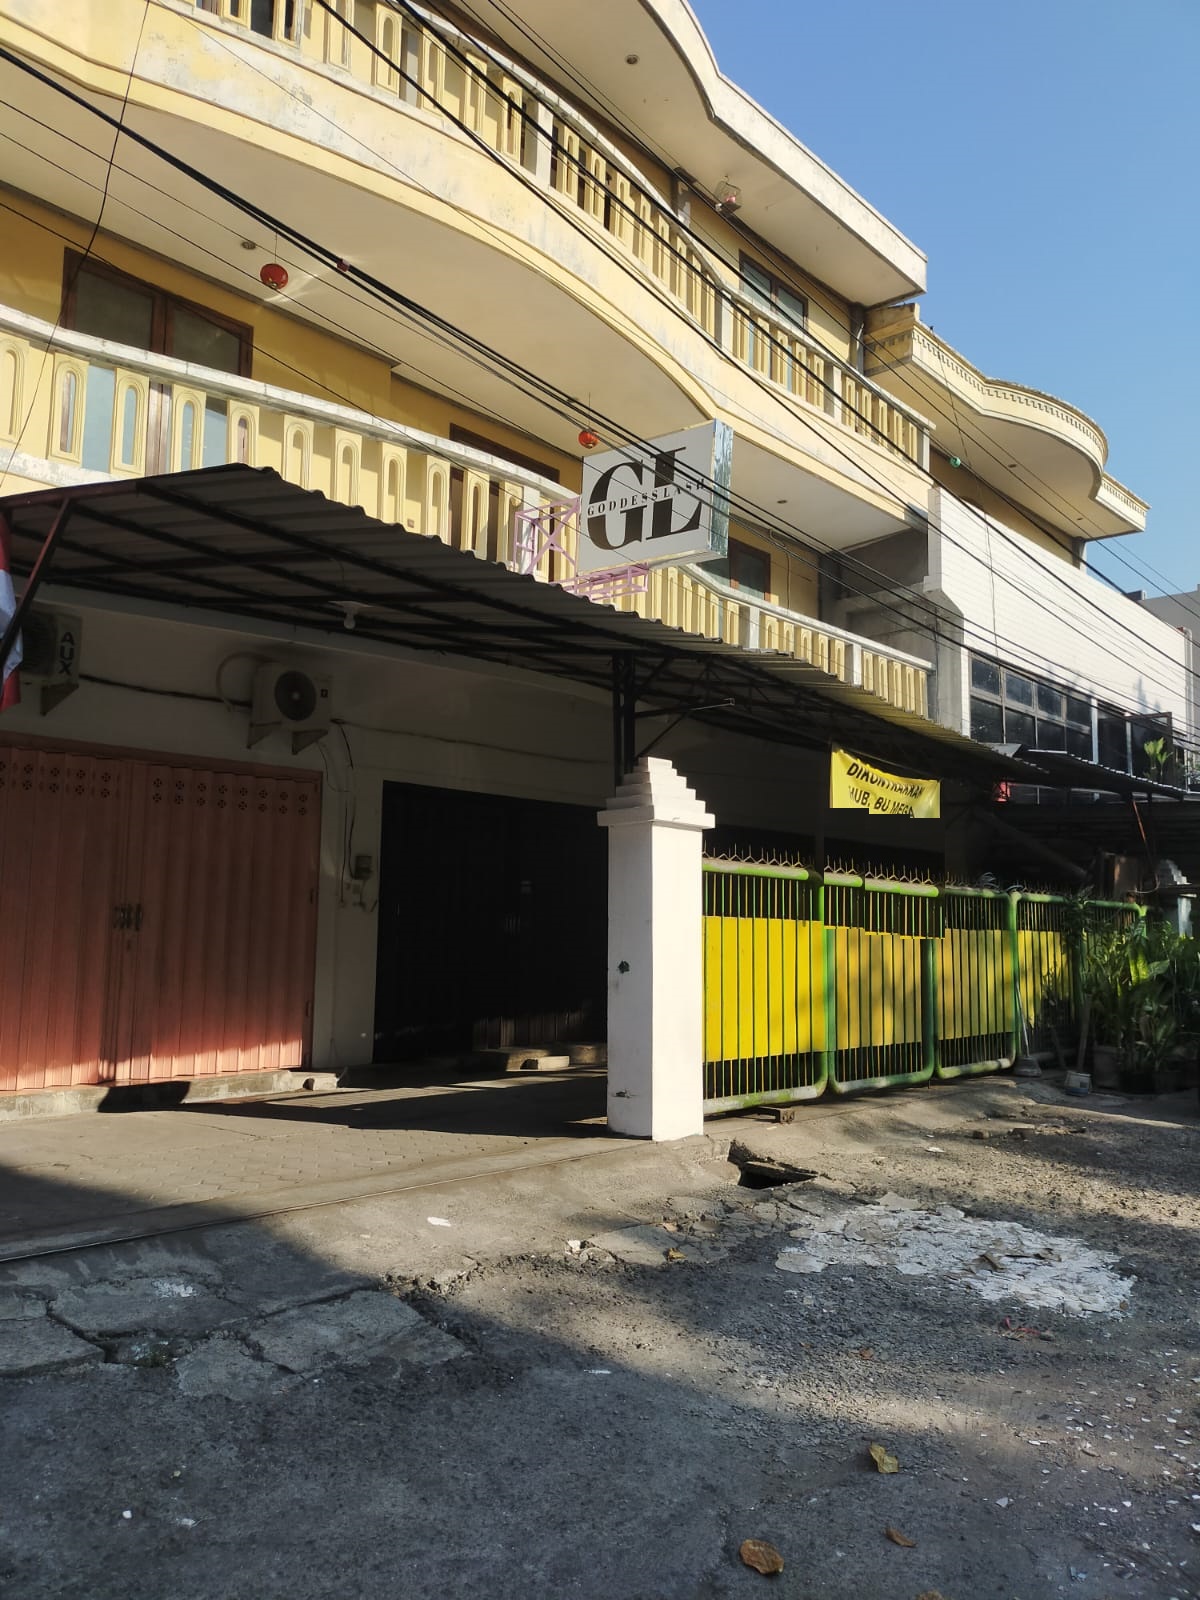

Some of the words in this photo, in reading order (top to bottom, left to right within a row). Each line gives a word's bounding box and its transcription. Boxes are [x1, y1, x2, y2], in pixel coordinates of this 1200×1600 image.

[587, 446, 703, 551] GL
[58, 631, 75, 676] AUX
[874, 796, 890, 812] BU
